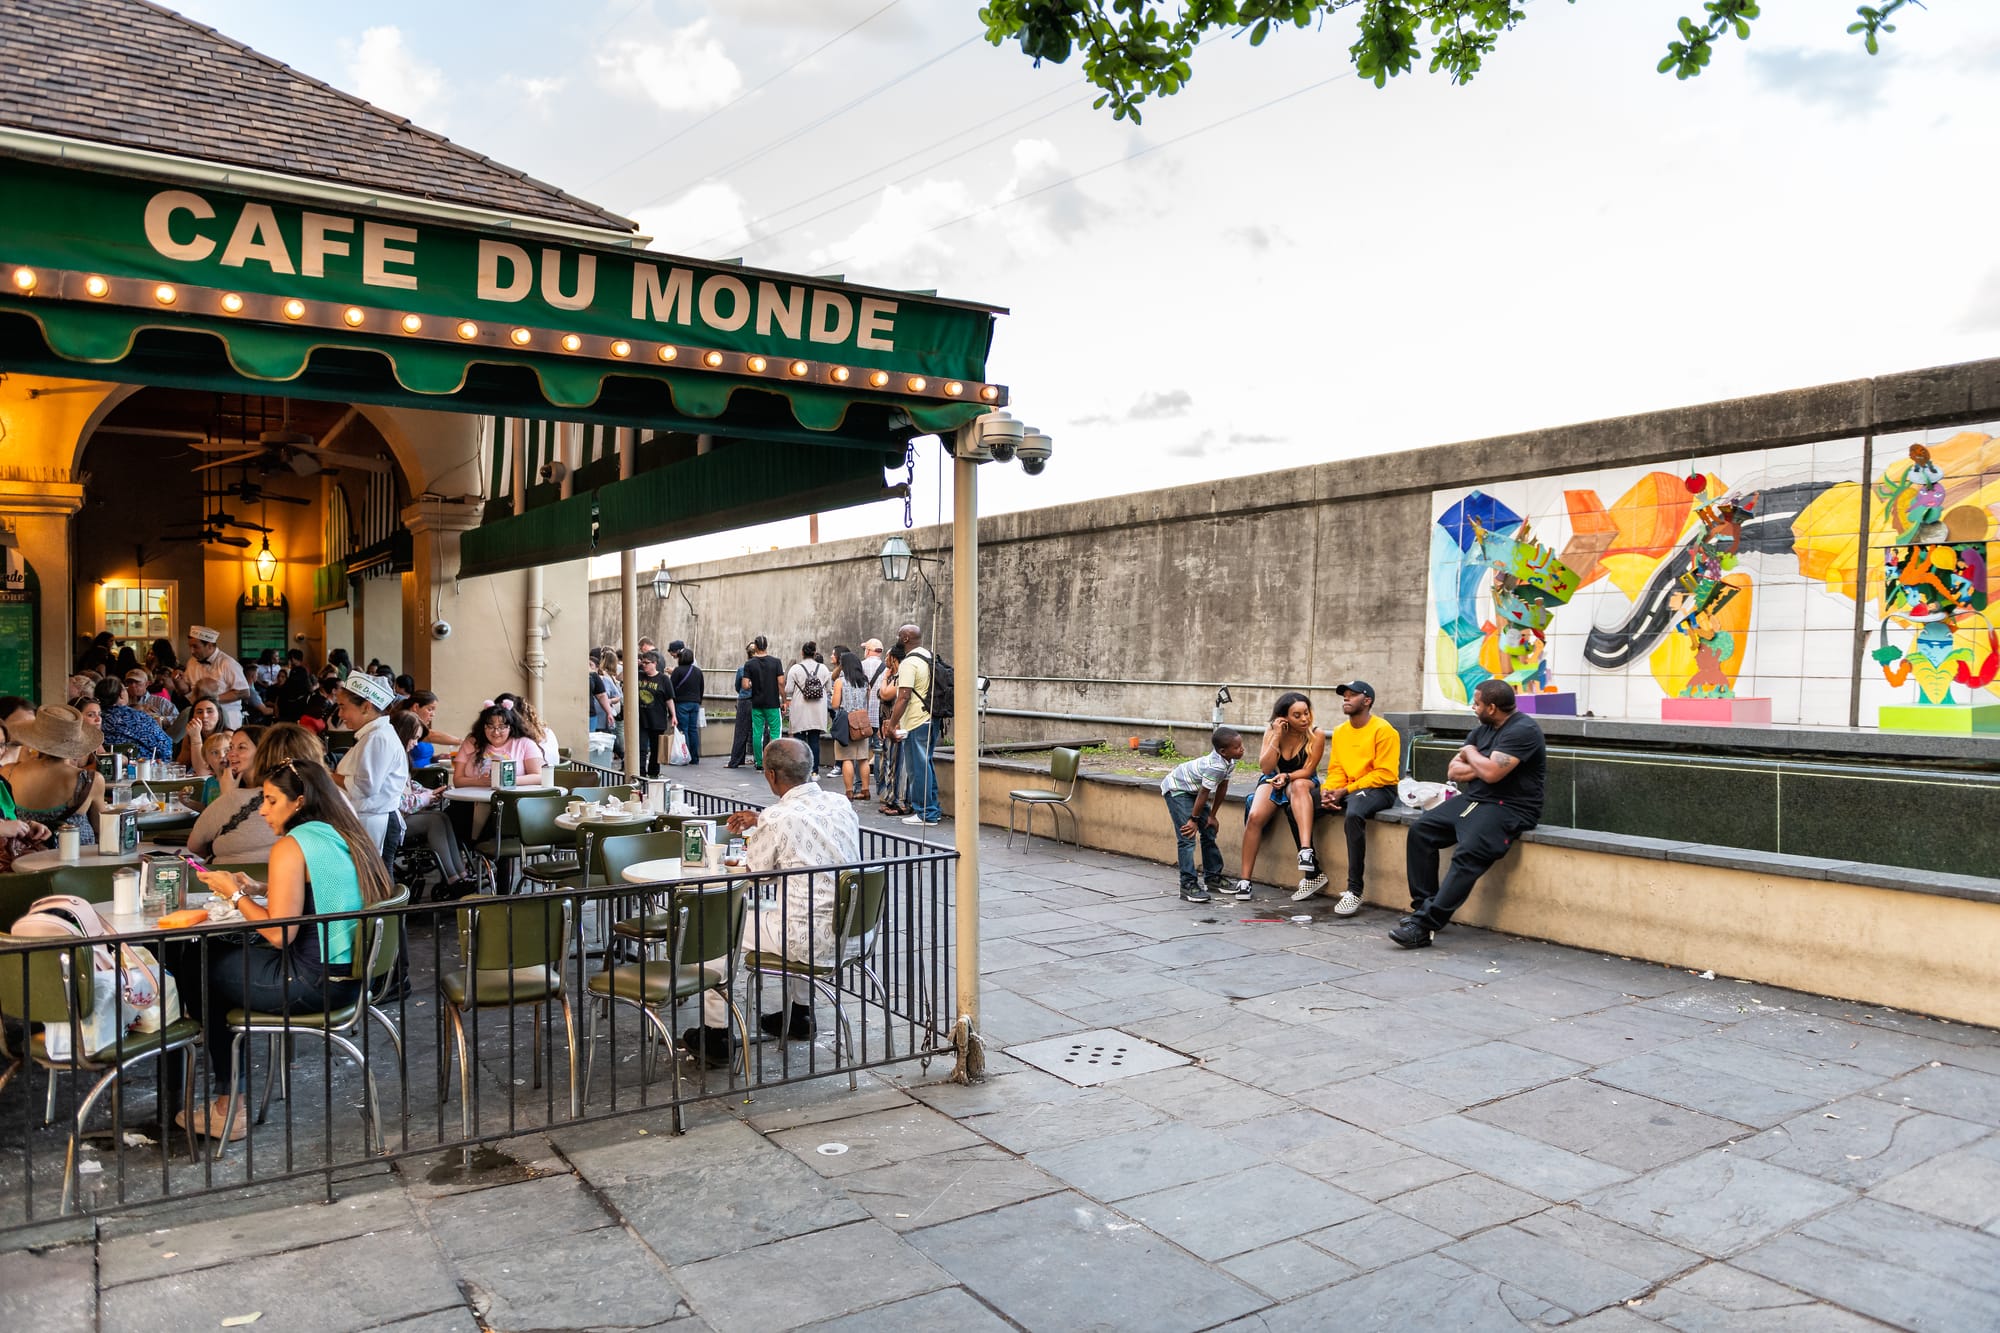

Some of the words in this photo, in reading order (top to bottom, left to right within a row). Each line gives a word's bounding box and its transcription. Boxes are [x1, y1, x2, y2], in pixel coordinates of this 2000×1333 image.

[144, 190, 418, 290] CAFE
[477, 239, 597, 311] DU
[631, 262, 898, 352] MONDE
